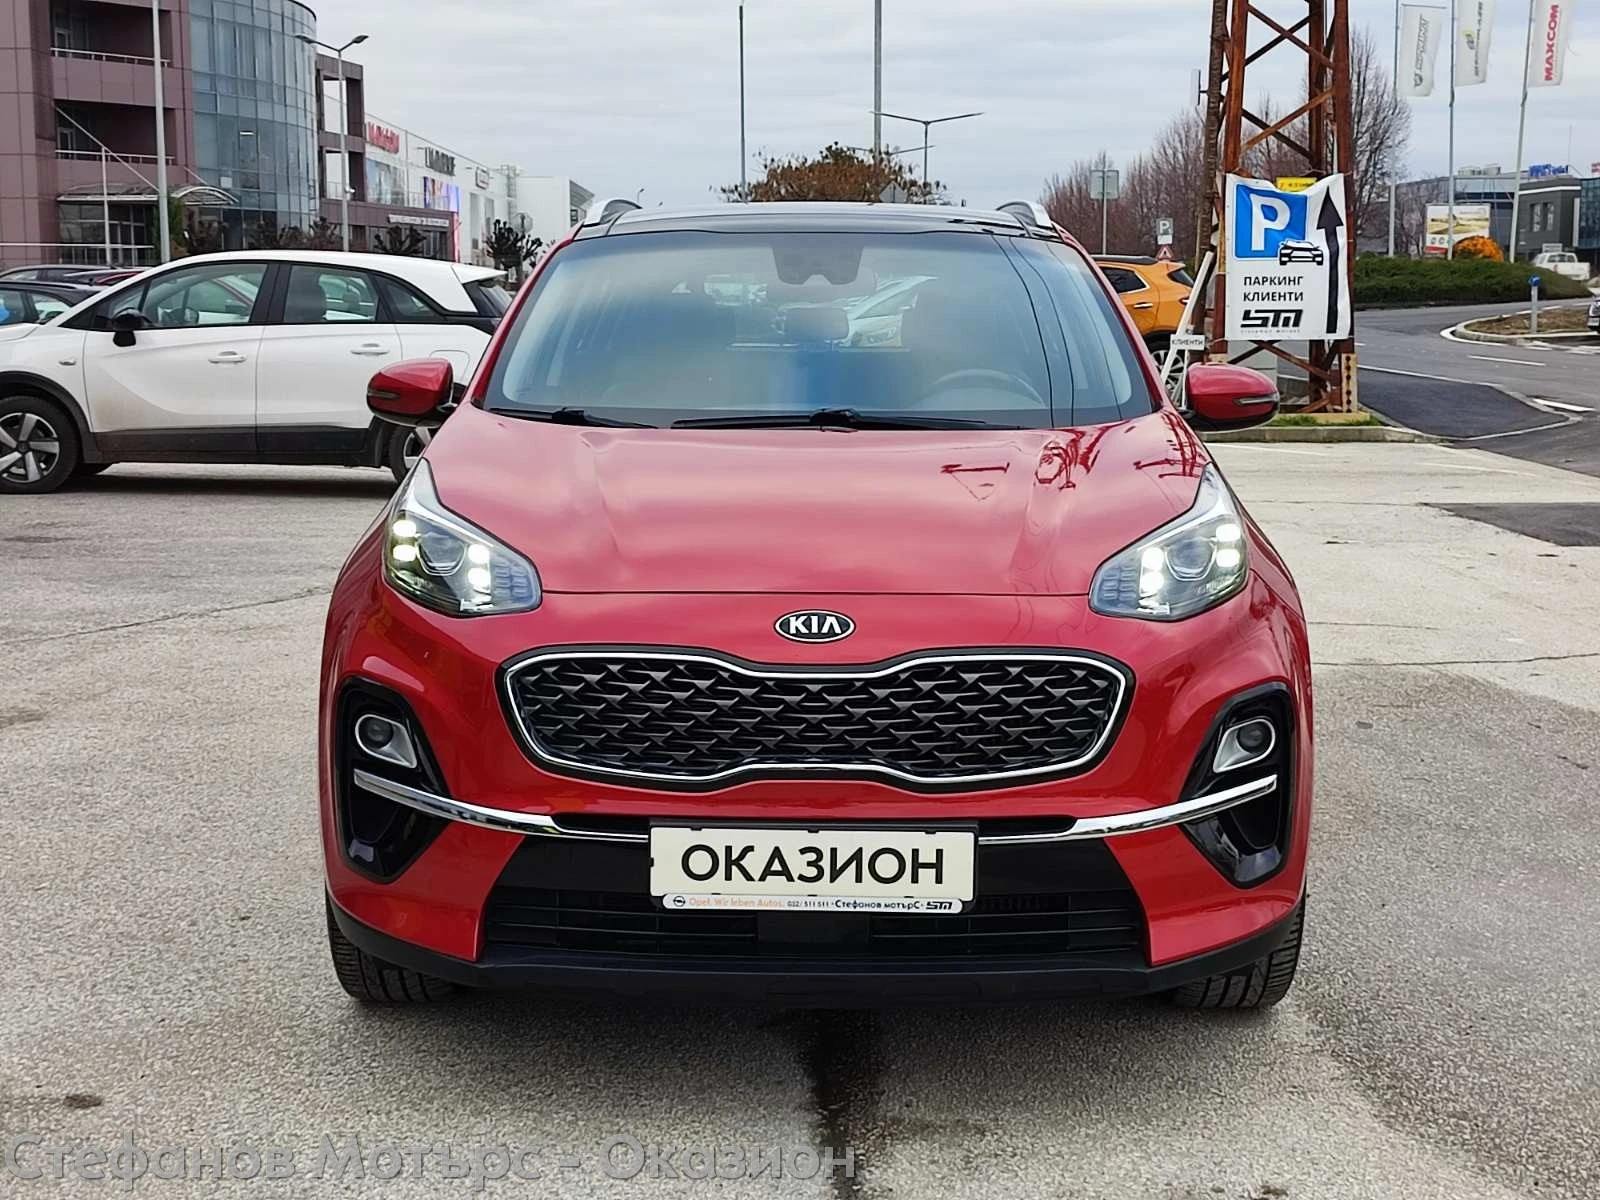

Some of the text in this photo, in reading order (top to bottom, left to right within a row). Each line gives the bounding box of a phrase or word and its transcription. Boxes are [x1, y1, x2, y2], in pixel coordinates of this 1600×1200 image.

[1544, 4, 1560, 81] MAXCOM
[1249, 193, 1291, 251] P
[1243, 275, 1304, 286] ПАРКИНГ
[1243, 291, 1304, 302] КЛИЕНТИ
[788, 615, 842, 634] KIA
[681, 844, 944, 885] ОКАЗИОН
[835, 899, 882, 910] Стефанов
